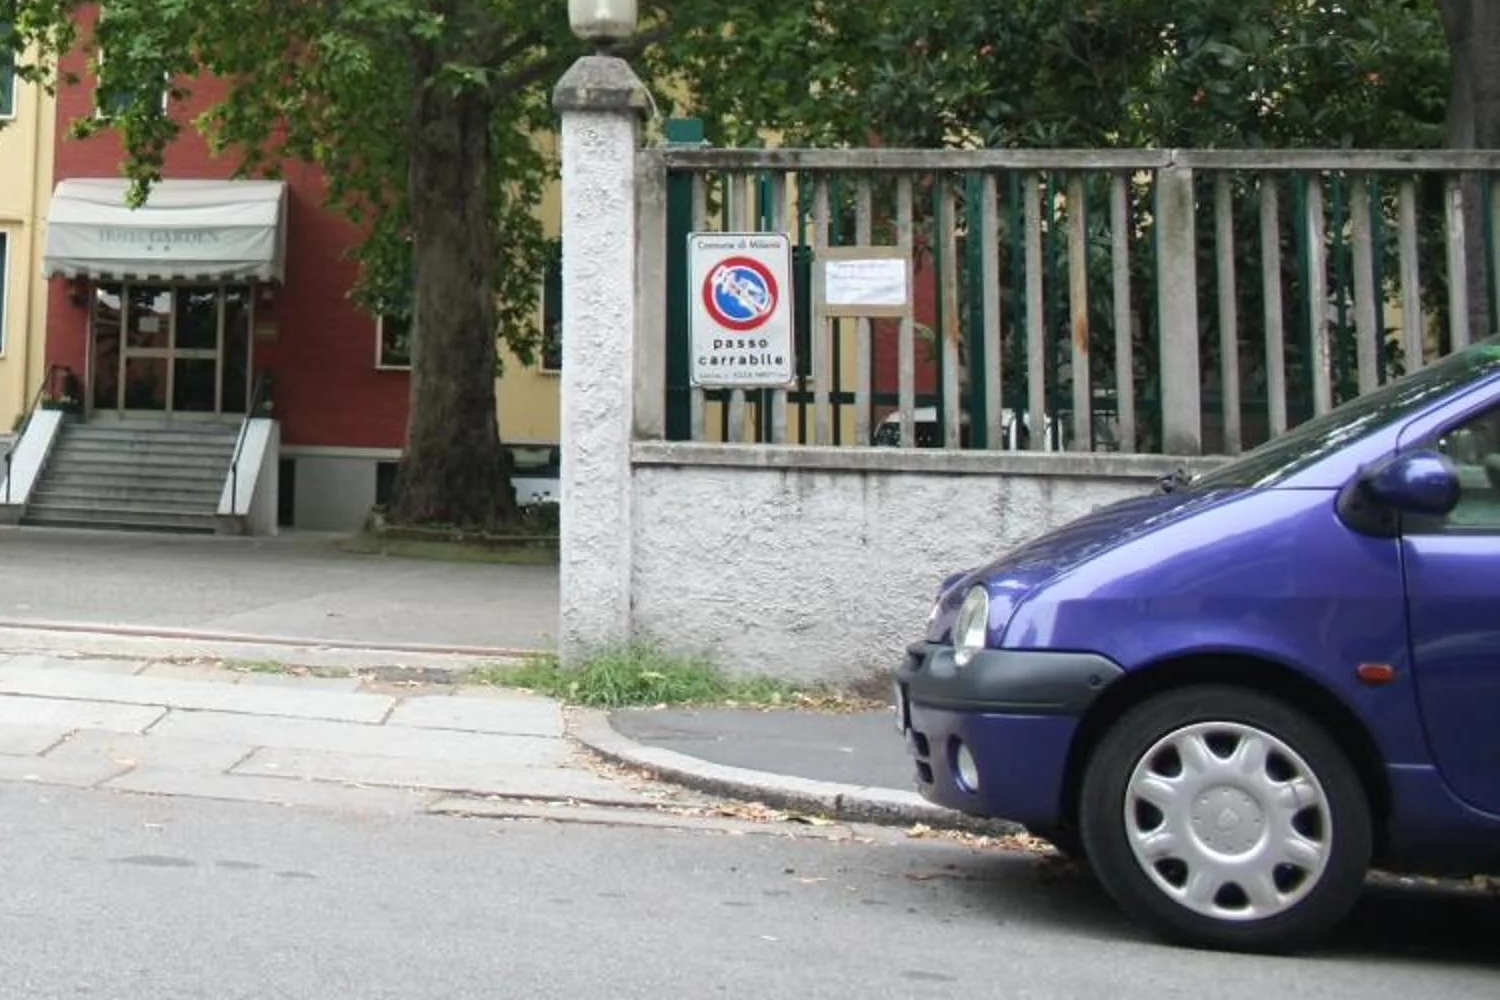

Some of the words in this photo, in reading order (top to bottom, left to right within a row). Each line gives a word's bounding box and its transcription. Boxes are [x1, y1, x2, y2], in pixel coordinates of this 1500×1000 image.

[149, 228, 220, 244] GARDEN
[713, 338, 769, 351] passo
[698, 352, 784, 366] carrabile
